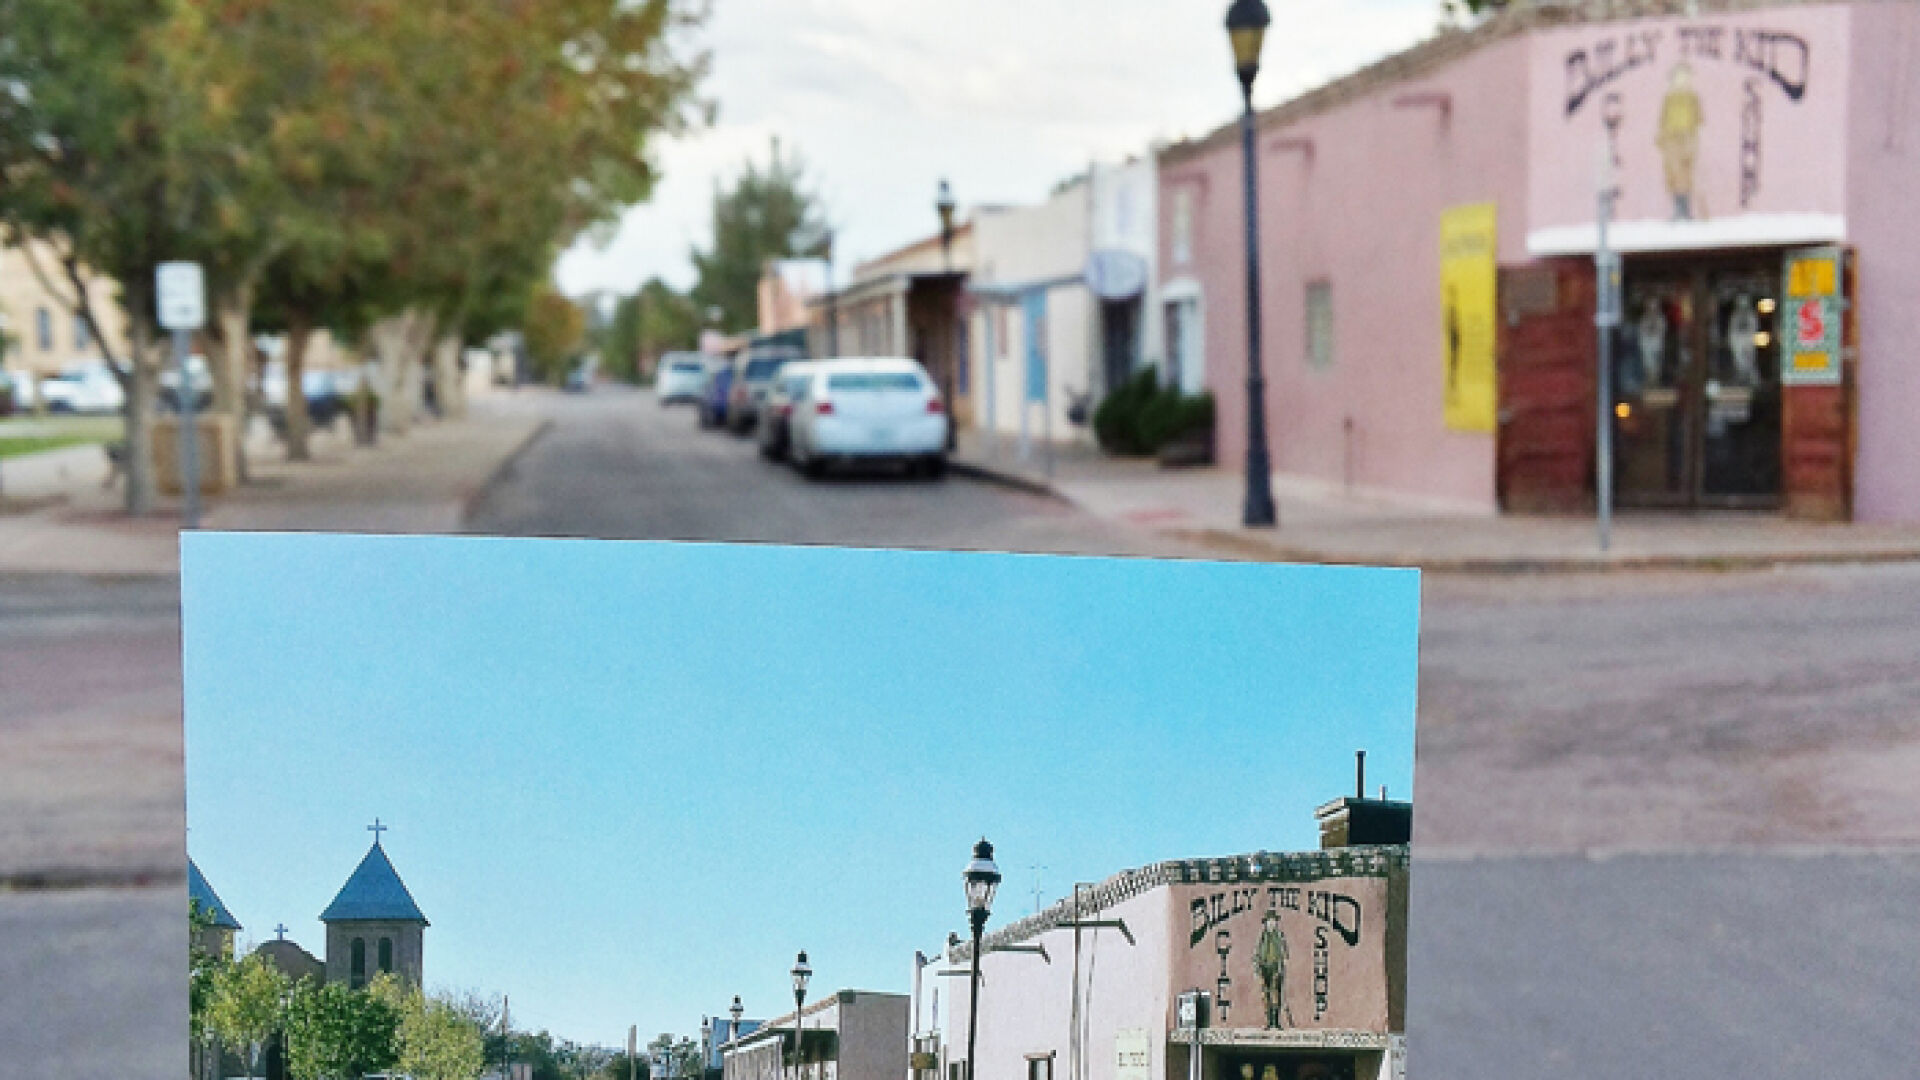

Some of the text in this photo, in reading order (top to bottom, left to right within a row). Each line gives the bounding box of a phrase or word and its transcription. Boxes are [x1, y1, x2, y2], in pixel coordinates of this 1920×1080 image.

[1735, 28, 1809, 102] KID
[1190, 888, 1361, 948] BILLY THE KID
[1314, 926, 1328, 1021] SHOP
